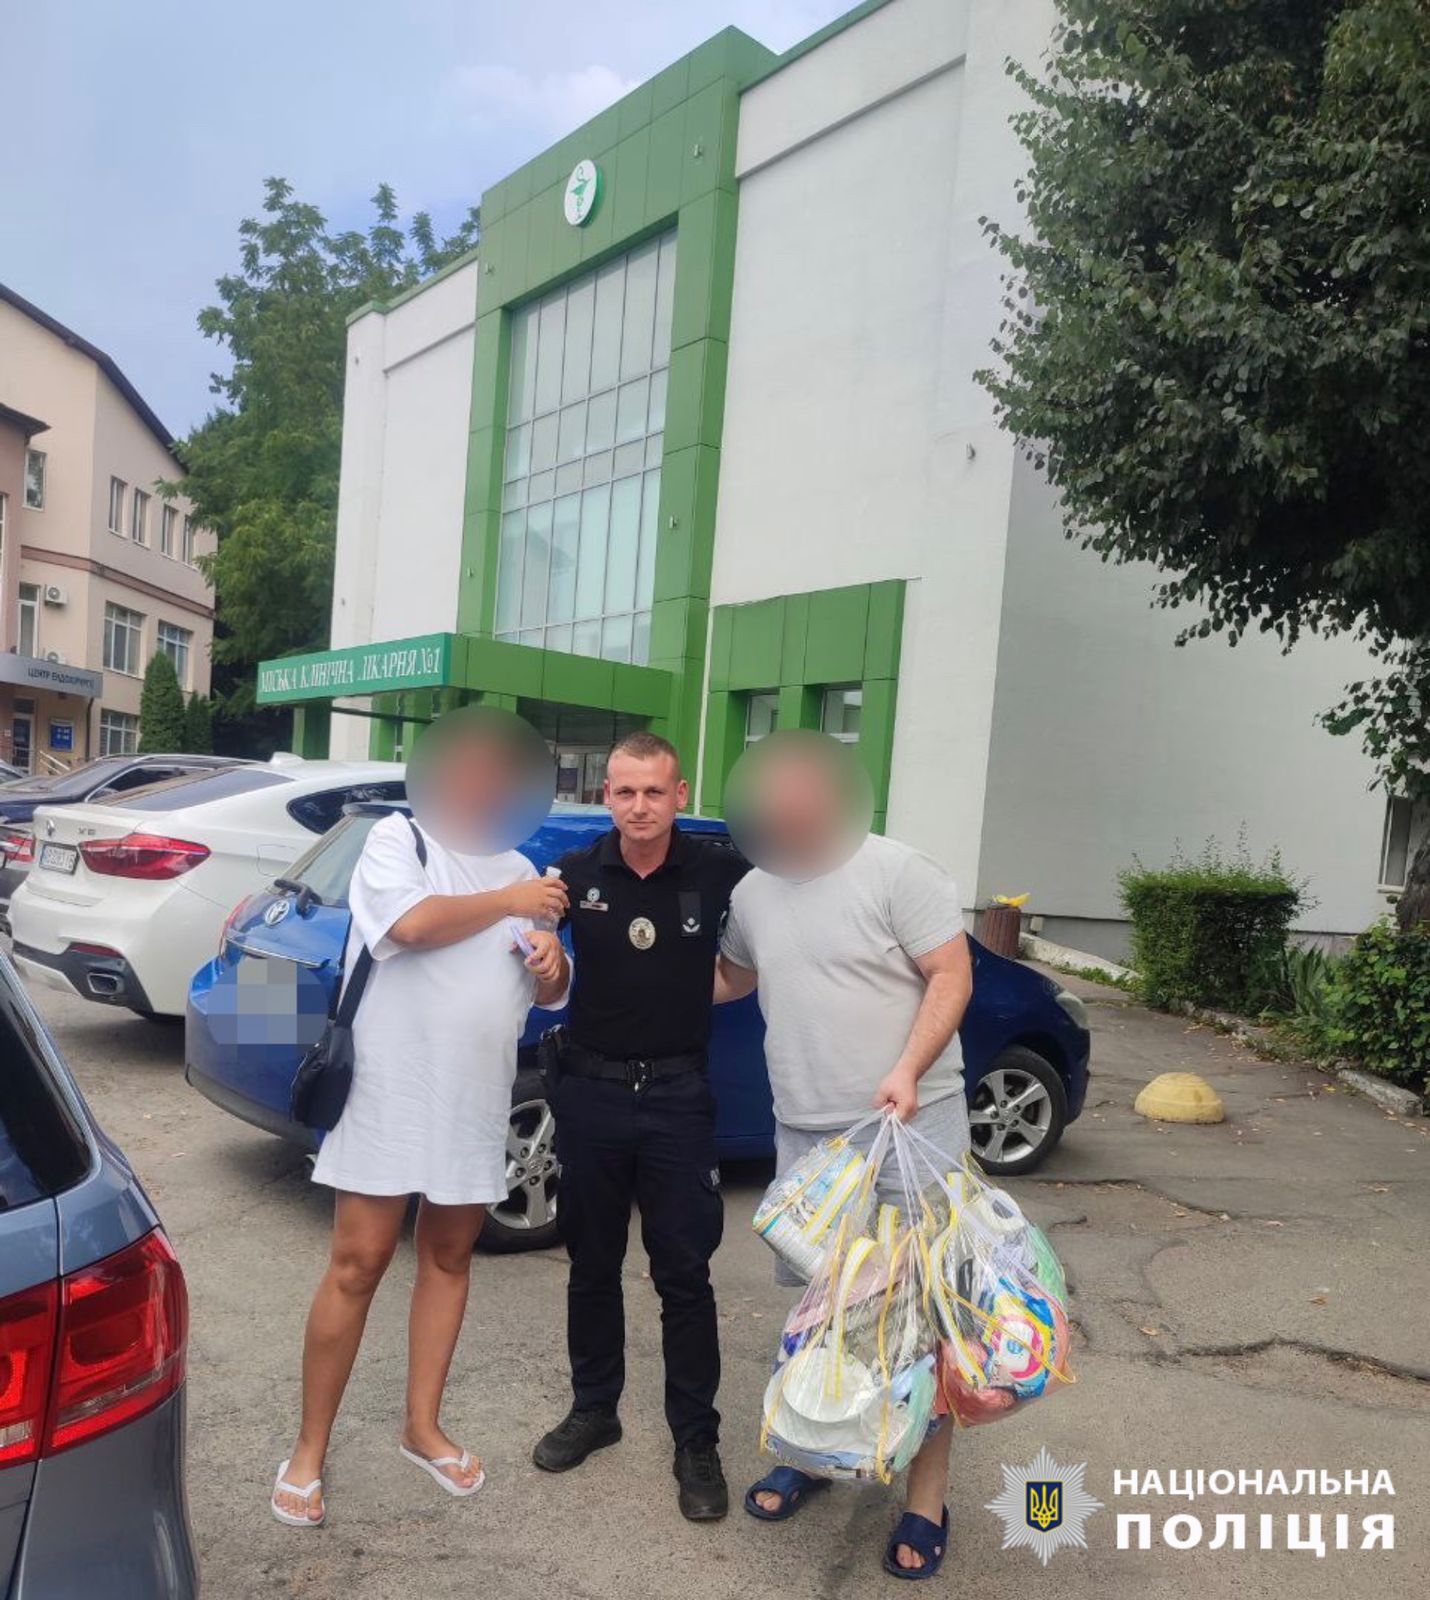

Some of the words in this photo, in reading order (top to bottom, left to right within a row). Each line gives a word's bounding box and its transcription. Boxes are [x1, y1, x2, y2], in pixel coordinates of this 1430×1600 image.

[28, 668, 50, 680] ЦЕНТР
[260, 669, 297, 692] МІСЬКА
[301, 660, 354, 687] КЛІНІЧНА
[358, 650, 417, 681] ЛІКАРНЯ
[418, 648, 440, 674] №1
